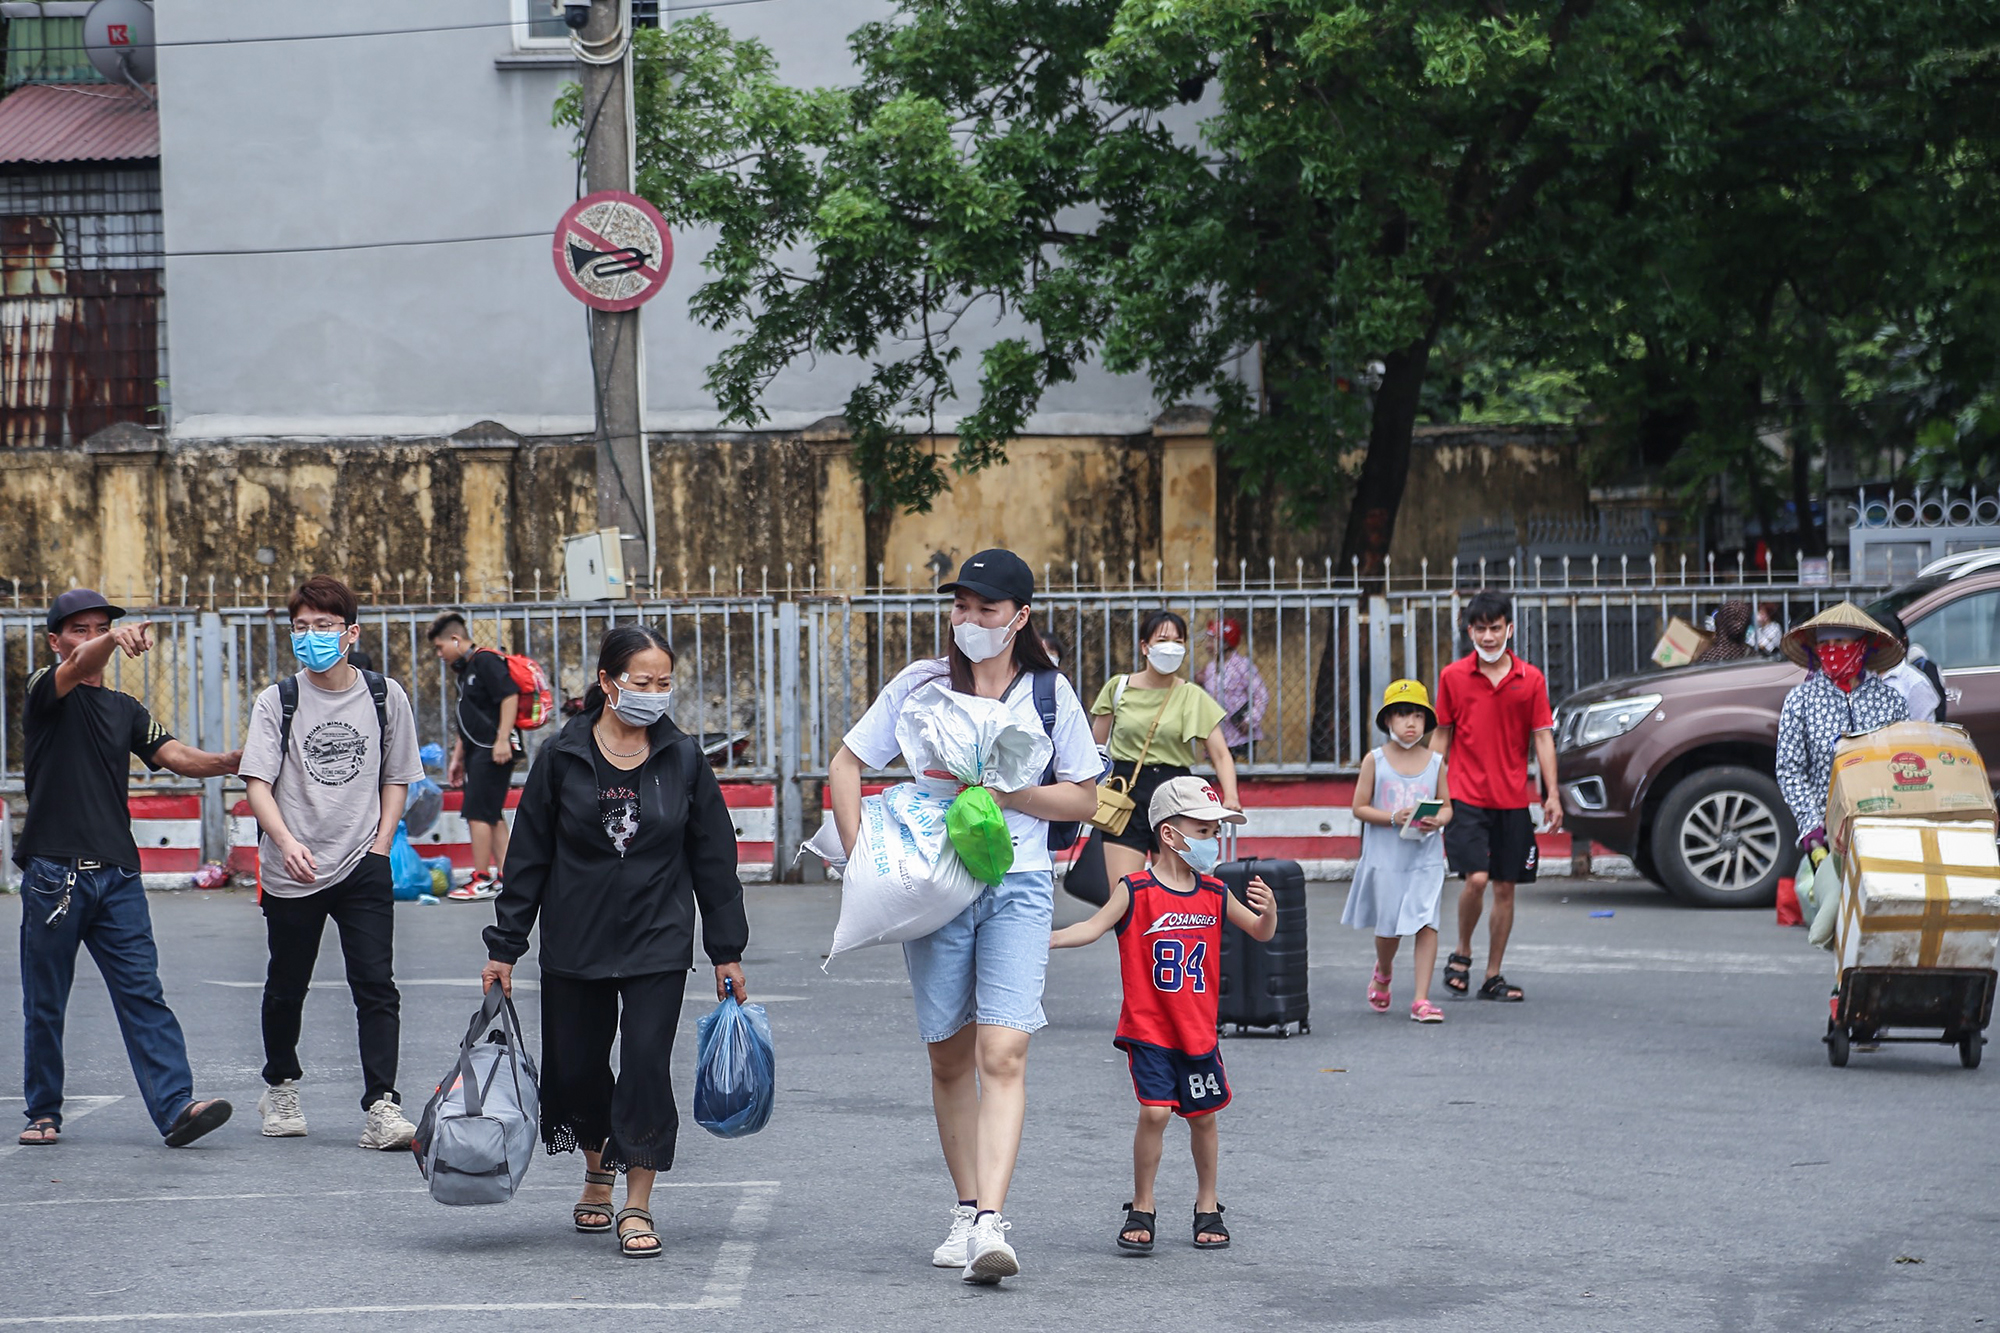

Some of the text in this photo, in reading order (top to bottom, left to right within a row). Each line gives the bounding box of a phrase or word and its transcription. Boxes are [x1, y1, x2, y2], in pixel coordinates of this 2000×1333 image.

[874, 850, 891, 877] YEAR
[1152, 938, 1207, 994] 84
[1189, 1073, 1222, 1100] 84
